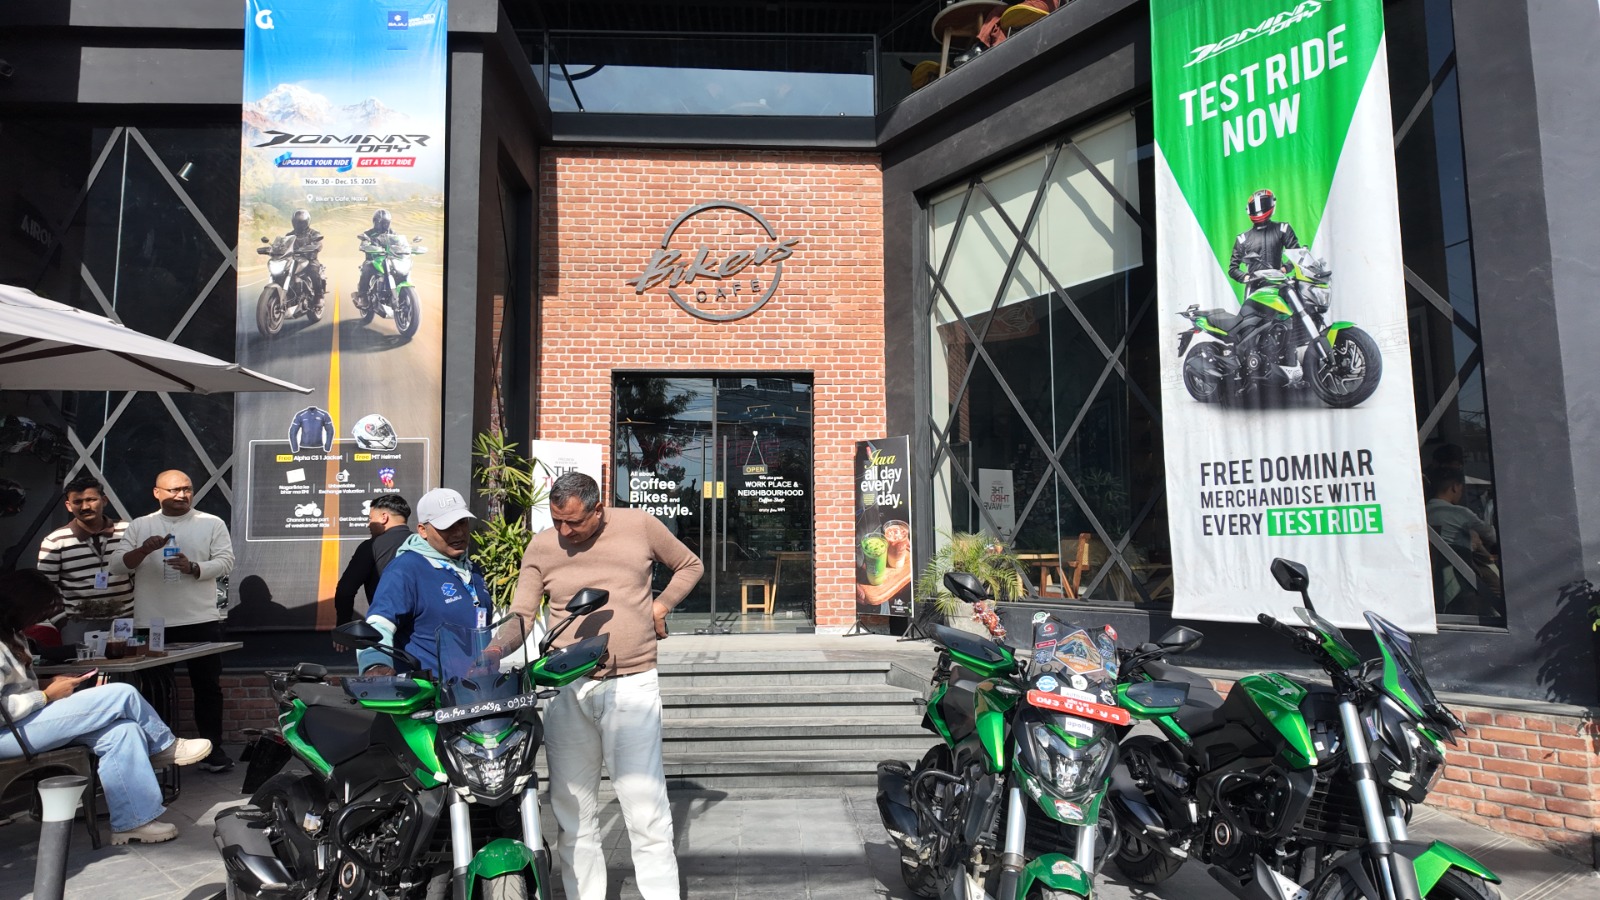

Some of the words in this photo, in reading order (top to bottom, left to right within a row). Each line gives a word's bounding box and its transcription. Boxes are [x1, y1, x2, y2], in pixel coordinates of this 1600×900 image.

[1179, 62, 1260, 127] TEST
[1266, 23, 1348, 96] RIDE
[1222, 92, 1301, 158] NOW
[254, 130, 431, 147] DOMINAR
[356, 145, 412, 153] DAY
[625, 237, 799, 295] Bikers
[696, 278, 761, 303] CAFE
[864, 449, 896, 469] Java
[1200, 459, 1254, 486] FREE
[1260, 449, 1375, 483] DOMINAR
[864, 466, 878, 481] all
[880, 466, 902, 483] day
[630, 478, 676, 490] Coffee
[860, 479, 895, 494] every
[630, 491, 668, 503] Bikes
[877, 493, 903, 508] day.
[1200, 484, 1324, 508] MERCHANDISE
[1328, 482, 1377, 503] WITH
[630, 504, 693, 518] festyle.
[1202, 513, 1264, 536] EVERY
[1272, 510, 1324, 534] TEST
[1327, 508, 1379, 534] RIDE
[1067, 721, 1091, 731] apollo
